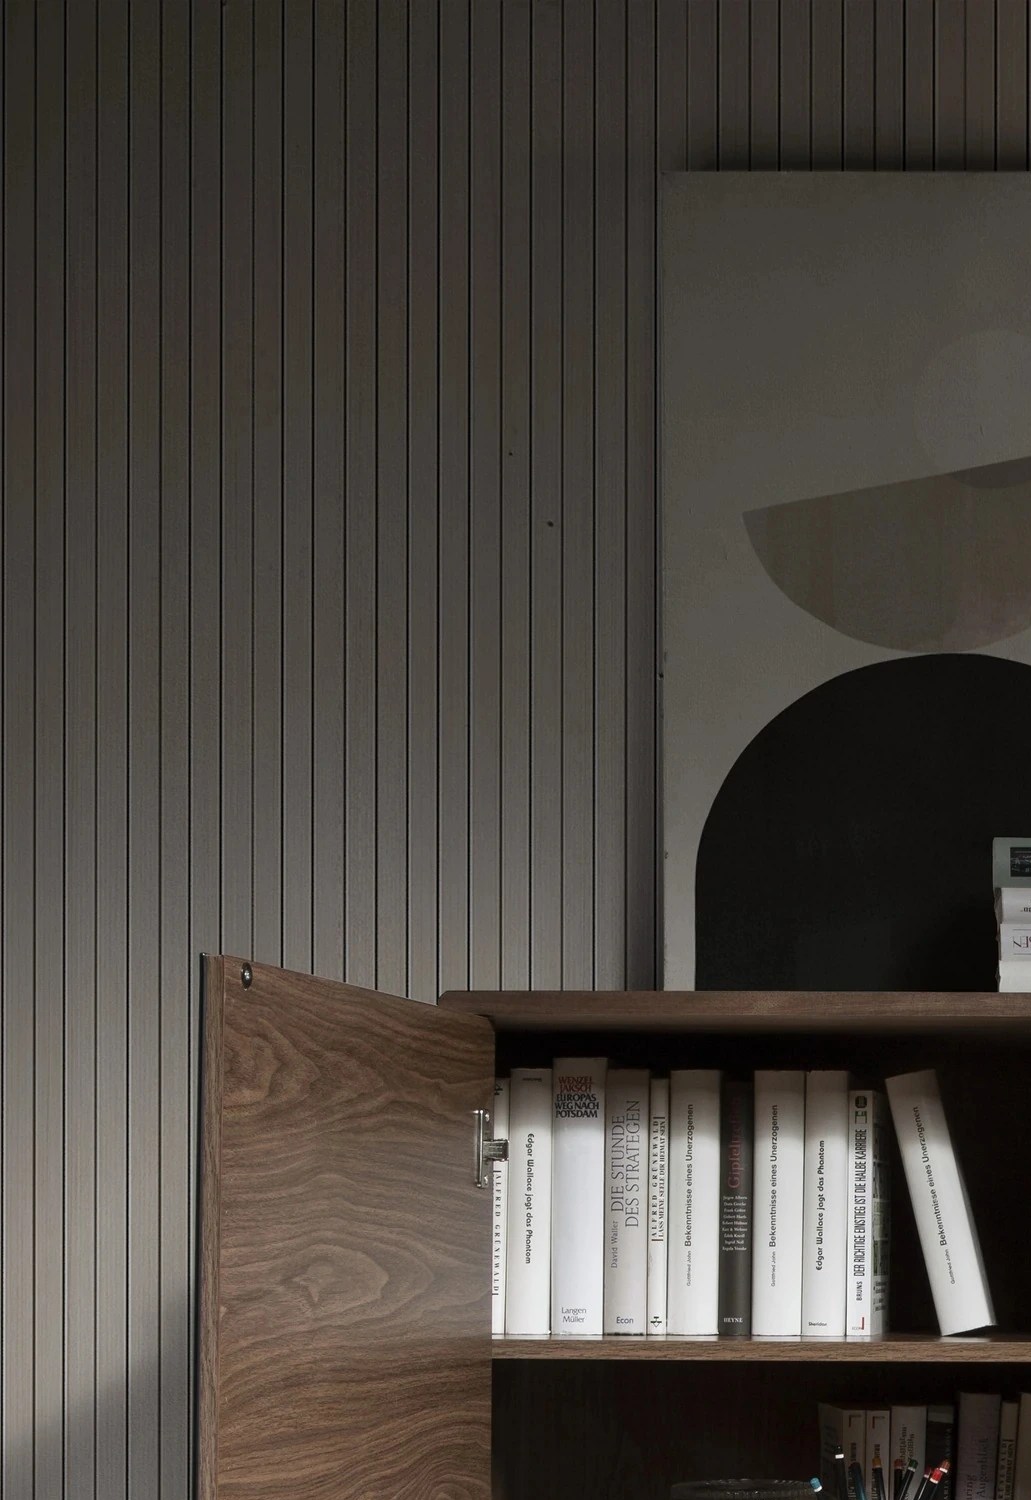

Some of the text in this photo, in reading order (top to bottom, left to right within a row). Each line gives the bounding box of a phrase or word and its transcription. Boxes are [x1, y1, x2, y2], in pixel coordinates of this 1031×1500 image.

[558, 1076, 593, 1085] WENZEL
[559, 1084, 592, 1093] JAKSCH
[554, 1101, 600, 1110] WEG NACH
[556, 1093, 597, 1102] EUROPAS
[555, 1109, 598, 1119] POTSDAM
[685, 1104, 694, 1161] Unerzogenen
[770, 1104, 779, 1162] Unerzogenen
[855, 1129, 867, 1160] KARRIERE
[912, 1106, 930, 1163] Unerzogenen
[526, 1133, 535, 1157] Edgar
[651, 1120, 659, 1188] GRÜNEWALD
[611, 1115, 625, 1212] DIE STUNDE
[625, 1100, 640, 1227] DES STRATEGEN
[817, 1140, 825, 1175] Phantom
[526, 1160, 534, 1191] Wallace
[685, 1163, 693, 1187] eines
[769, 1164, 777, 1187] eines
[854, 1161, 867, 1182] HALBE
[924, 1165, 935, 1187] eines
[854, 1183, 867, 1193] DIE
[854, 1195, 866, 1204] IST
[524, 1193, 534, 1211] jagt
[816, 1193, 825, 1211] jagt
[684, 1188, 692, 1247] Bekenntnisse
[769, 1189, 777, 1248] Bekenntnisse
[816, 1212, 824, 1245] Wallace
[854, 1206, 866, 1234] EINSTIEG
[930, 1189, 947, 1246] Bekenntnisse
[611, 1220, 619, 1245] Waller
[525, 1230, 533, 1264] Phantom
[815, 1247, 824, 1270] Edgar
[854, 1235, 866, 1263] RICHTIGE
[853, 1264, 866, 1277] DER
[561, 1306, 587, 1316] Langen
[562, 1315, 585, 1324] Müller
[616, 1316, 634, 1324] Econ
